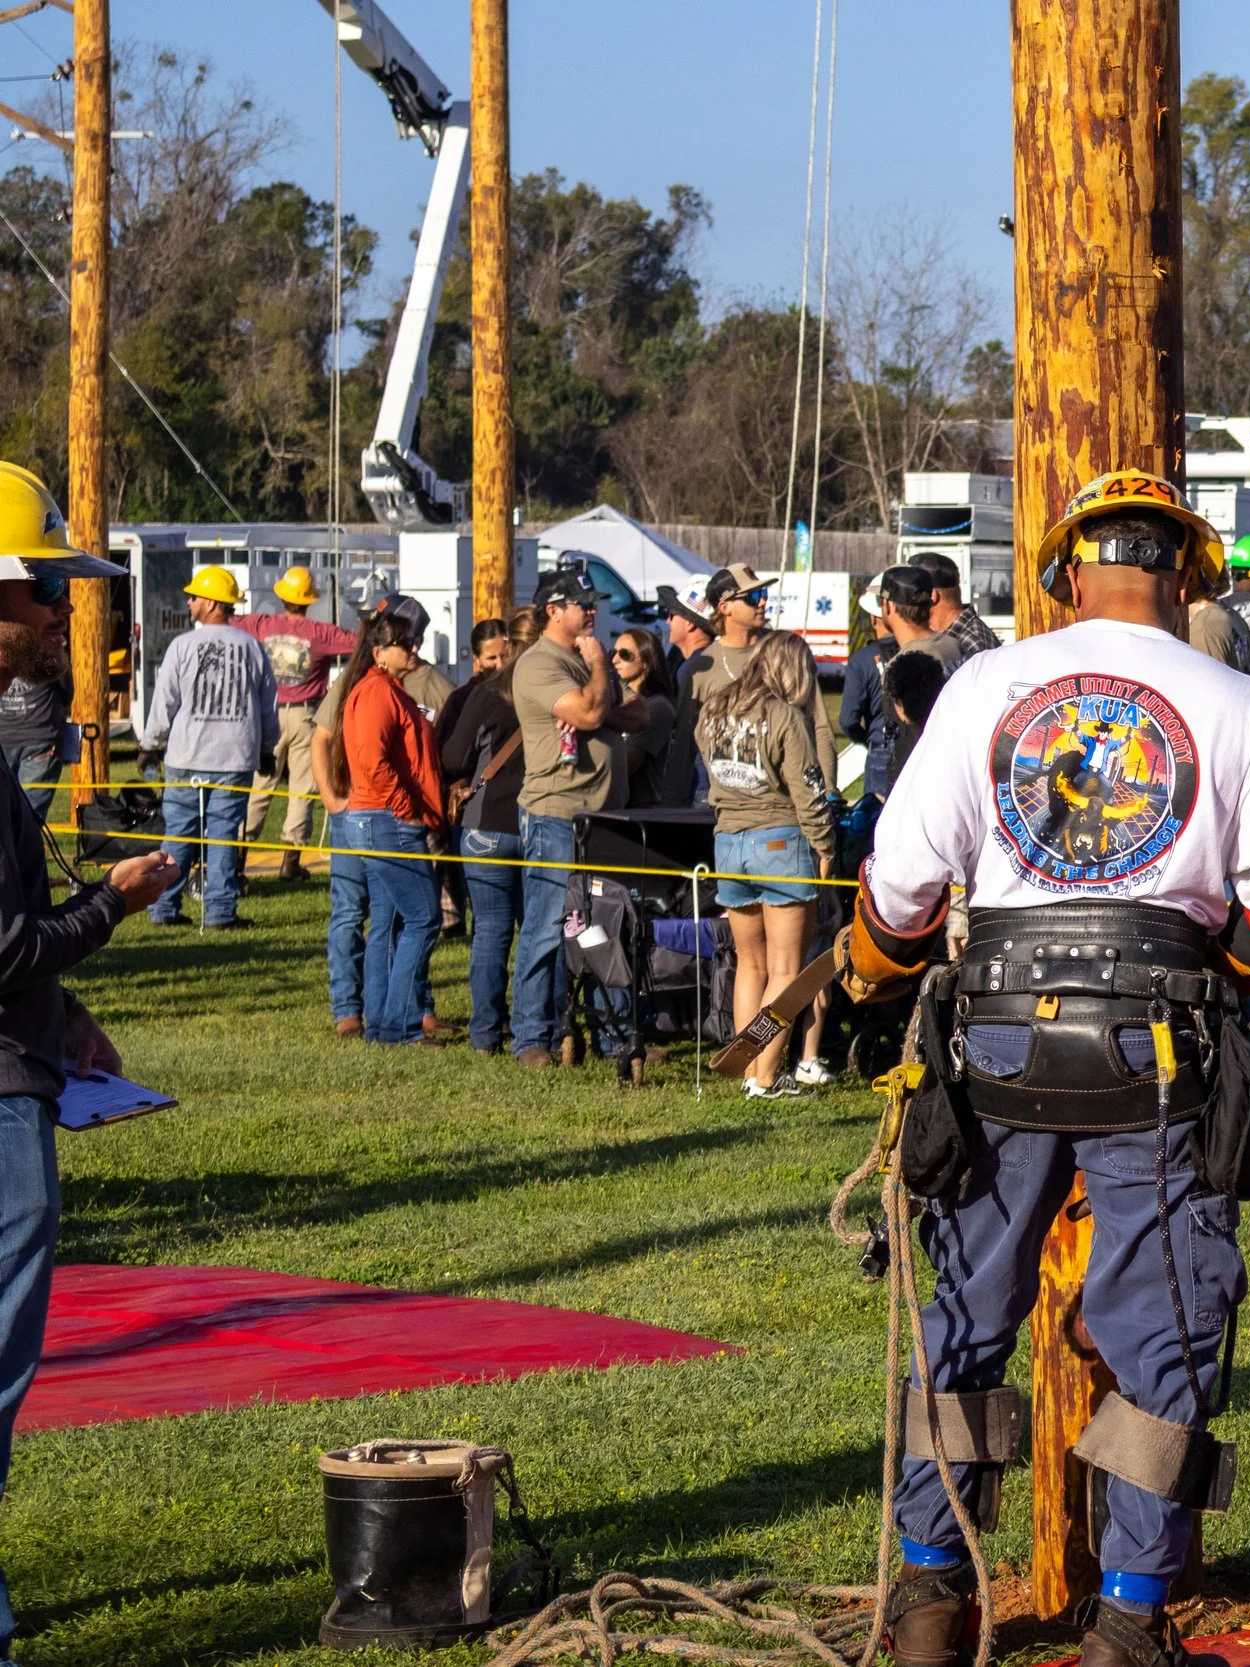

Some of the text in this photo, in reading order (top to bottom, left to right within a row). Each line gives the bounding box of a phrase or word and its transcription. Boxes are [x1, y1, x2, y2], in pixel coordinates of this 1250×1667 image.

[1004, 677, 1194, 765] KISSIMMEE UTILITY AUTHORITY
[1078, 696, 1141, 729] KUA
[997, 782, 1183, 880] LEADING THE CHARGE
